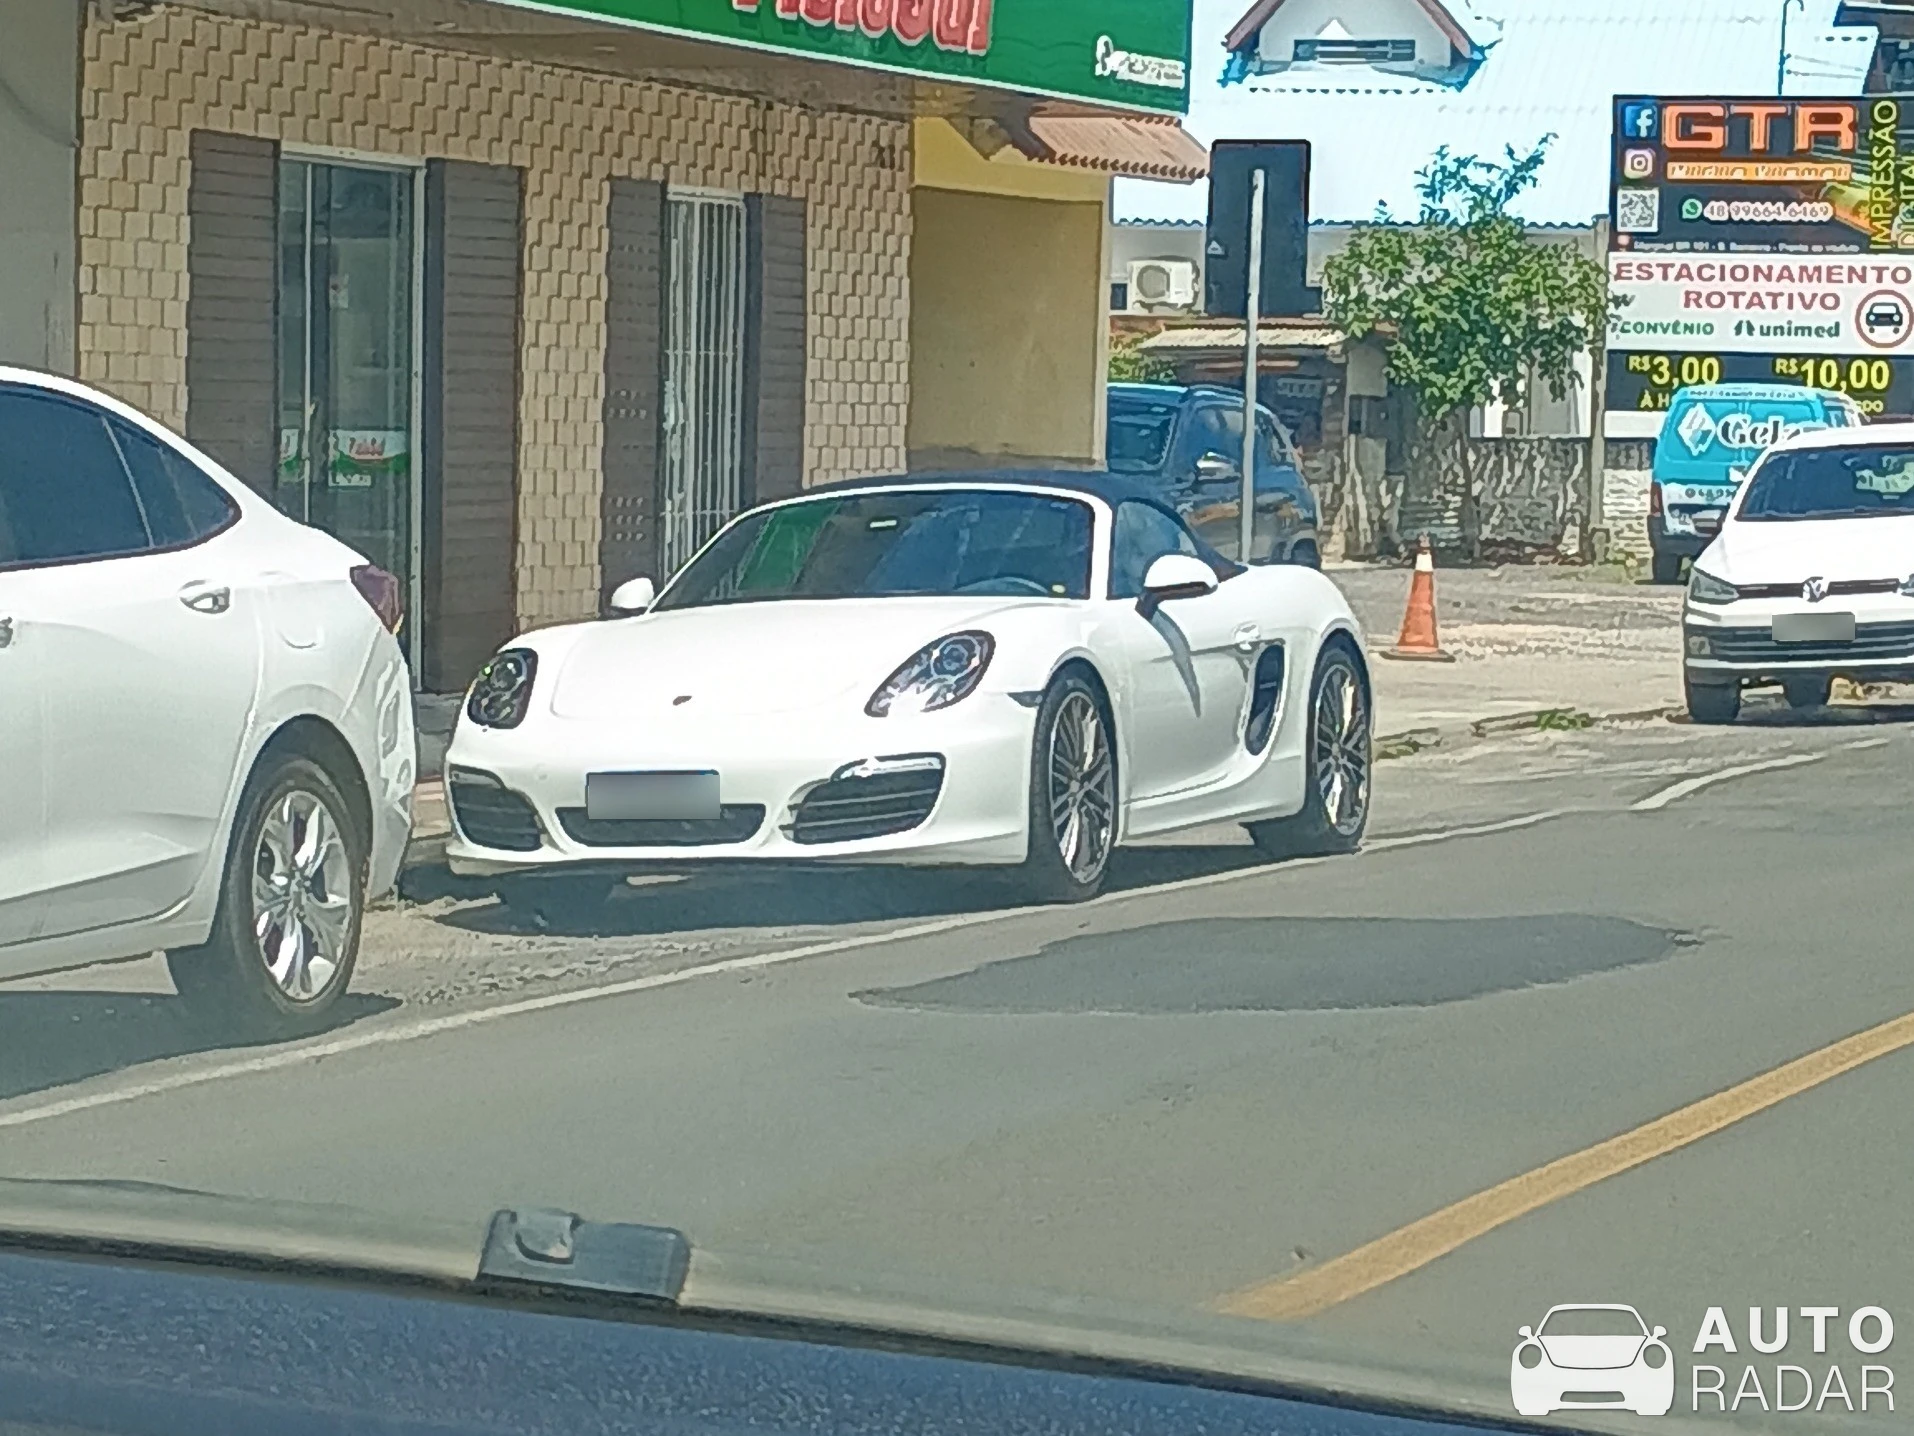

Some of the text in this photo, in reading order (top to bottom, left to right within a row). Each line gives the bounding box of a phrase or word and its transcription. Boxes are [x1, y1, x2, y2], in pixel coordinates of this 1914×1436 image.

[1663, 104, 1857, 150] GTR
[1869, 101, 1897, 249] IMPRESSÃO
[1614, 262, 1912, 284] ESTACIONAMENTO
[1684, 290, 1840, 310] ROTATIVO
[1620, 319, 1714, 335] CONVÊNIO
[1760, 320, 1840, 338] unimed
